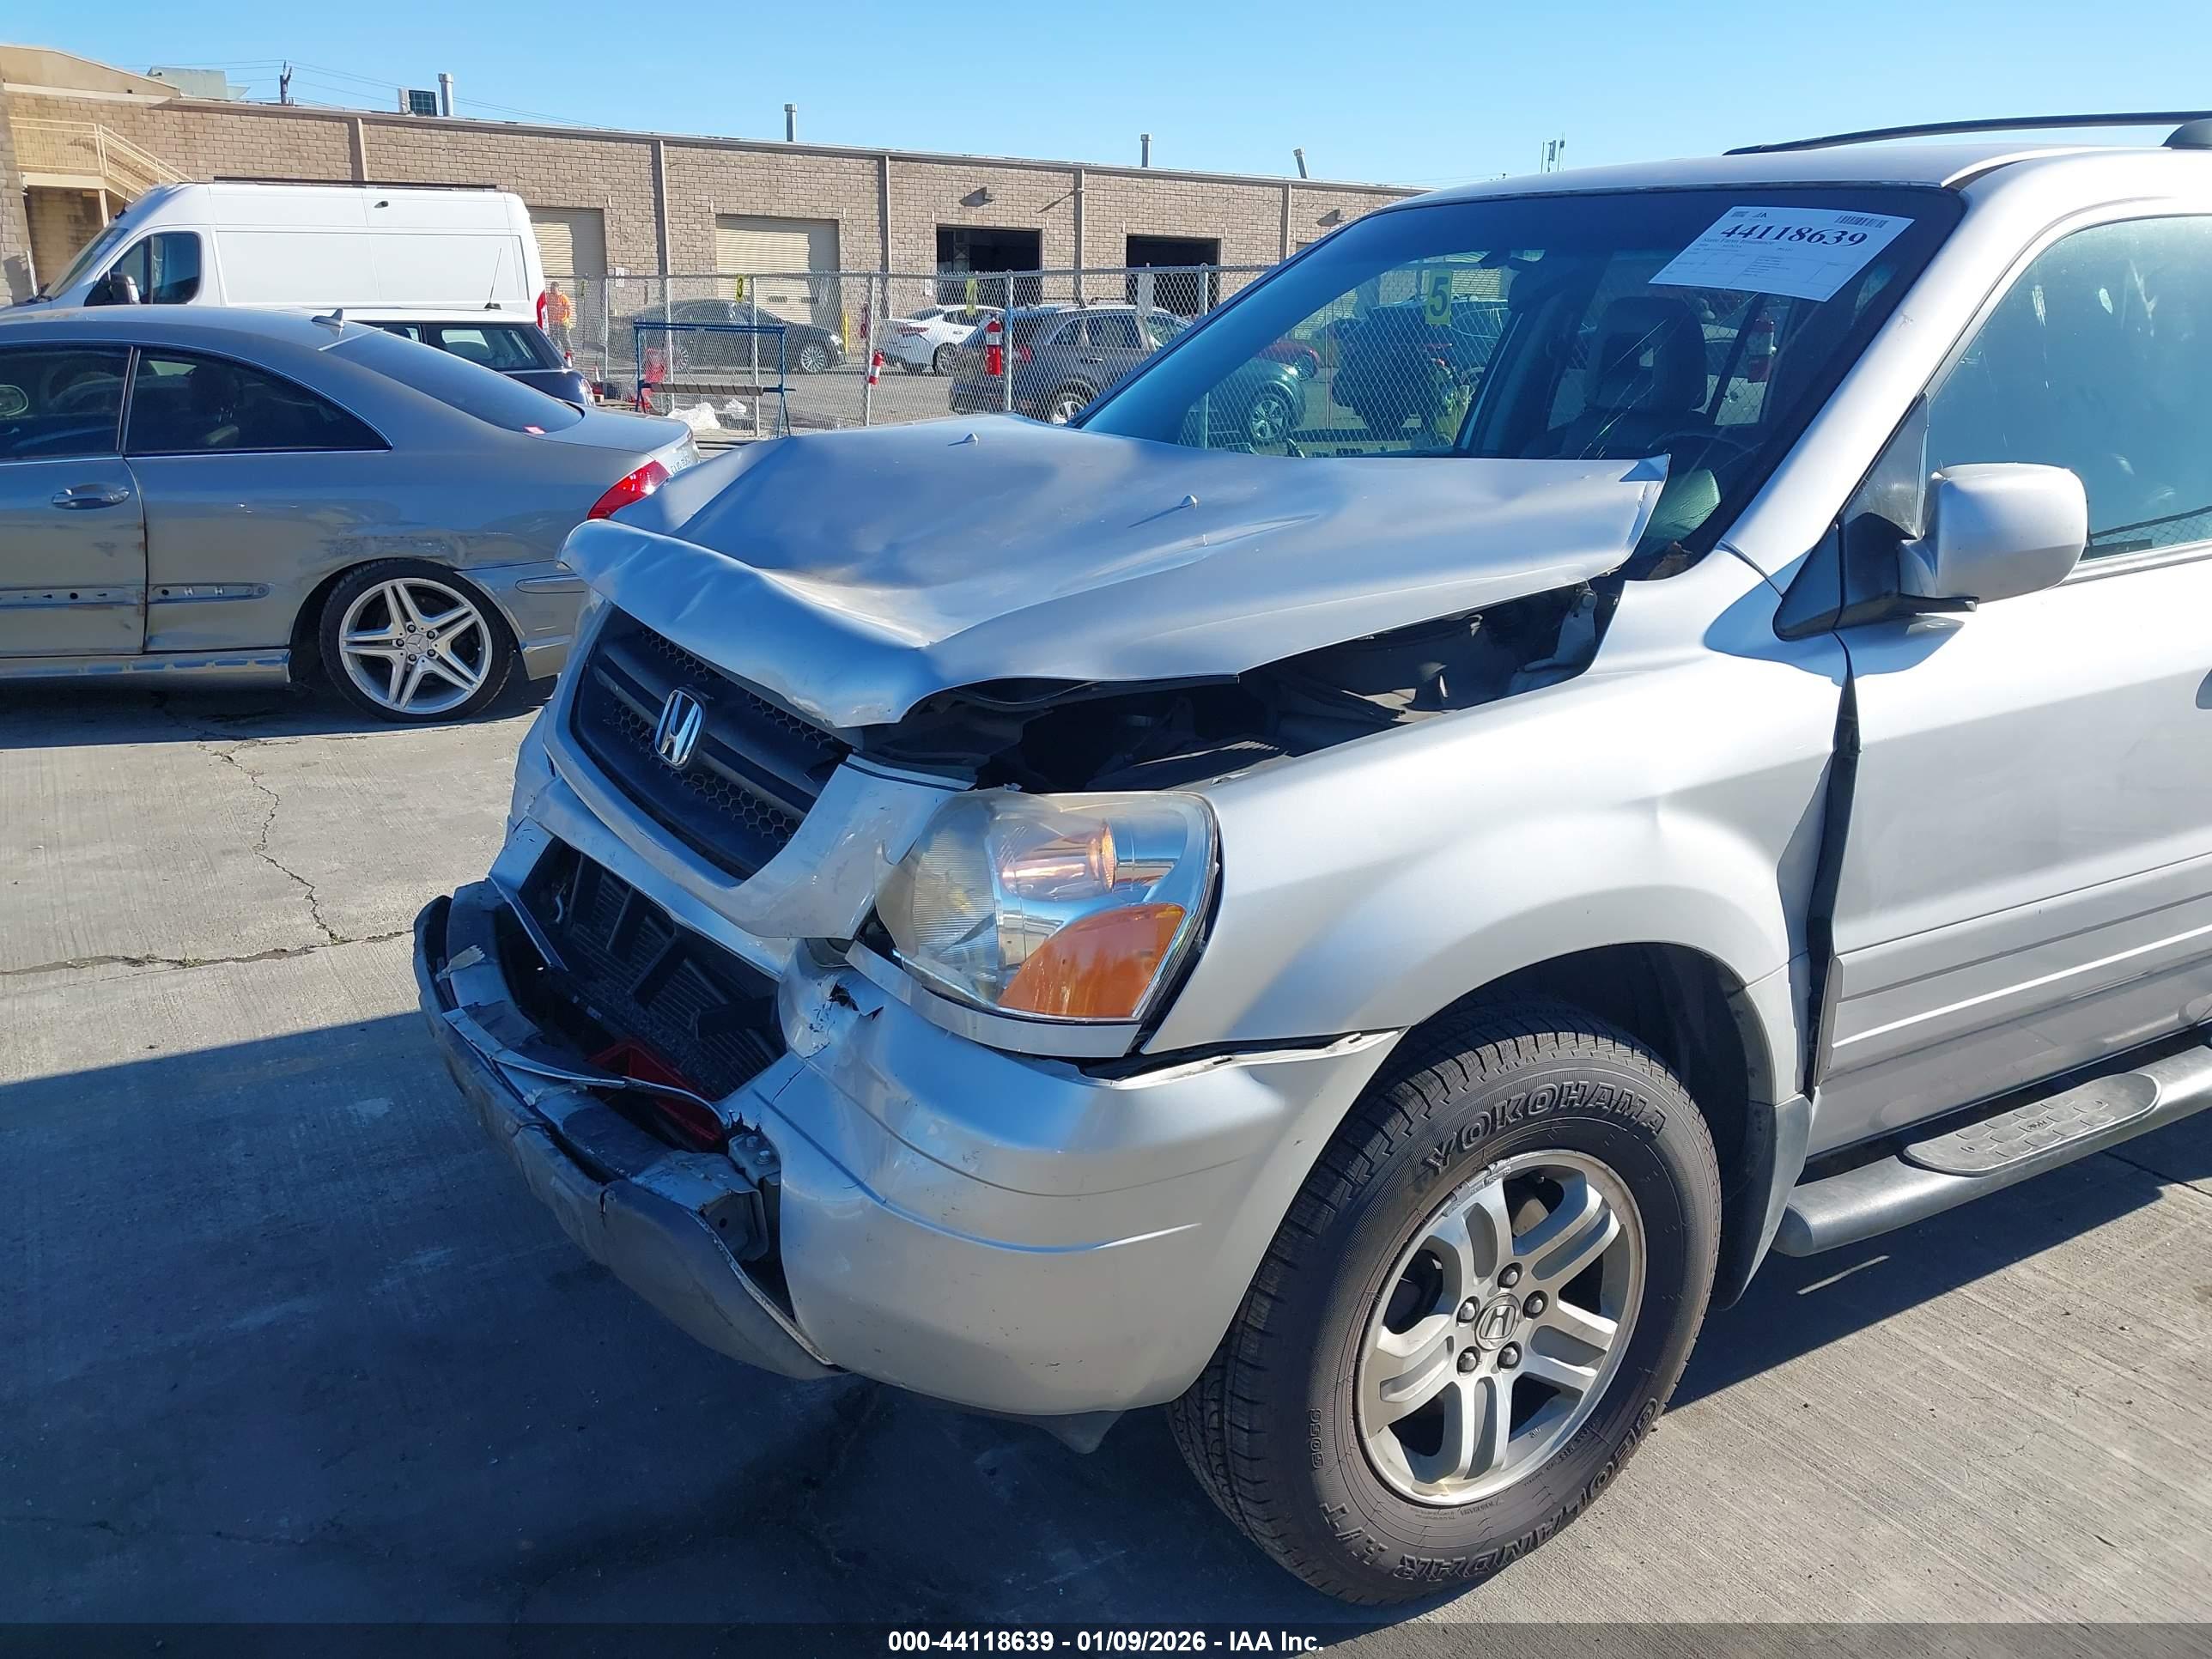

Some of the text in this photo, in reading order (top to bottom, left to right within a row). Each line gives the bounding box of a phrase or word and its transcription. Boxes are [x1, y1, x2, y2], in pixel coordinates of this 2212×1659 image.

[1720, 223, 1868, 248] 44118639
[737, 277, 744, 297] 3
[967, 283, 975, 310] 4
[1430, 276, 1449, 317] 5
[1425, 1080, 1665, 1174] YOKOHAMA
[1395, 1395, 1659, 1583] GEOLANDAR
